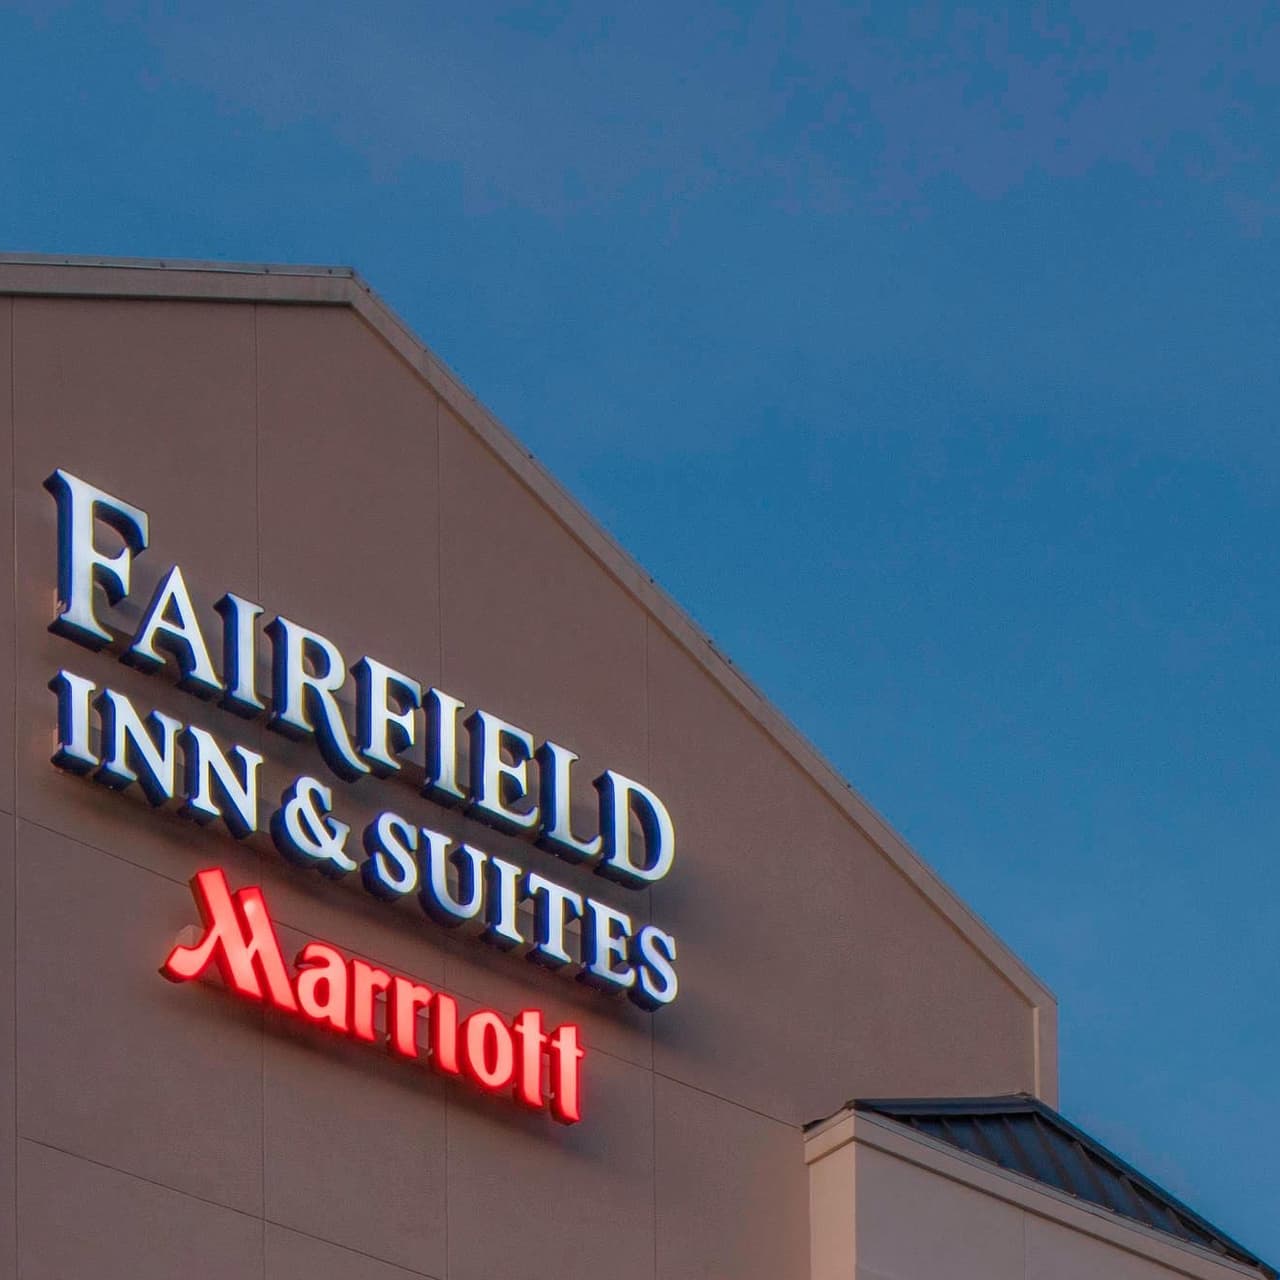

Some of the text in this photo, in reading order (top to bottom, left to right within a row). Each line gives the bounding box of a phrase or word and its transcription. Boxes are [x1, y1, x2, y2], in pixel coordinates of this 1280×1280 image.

[45, 468, 675, 888] FAIRFIELD
[50, 669, 678, 1010] INN & SUITES
[159, 866, 585, 1124] Marriott
